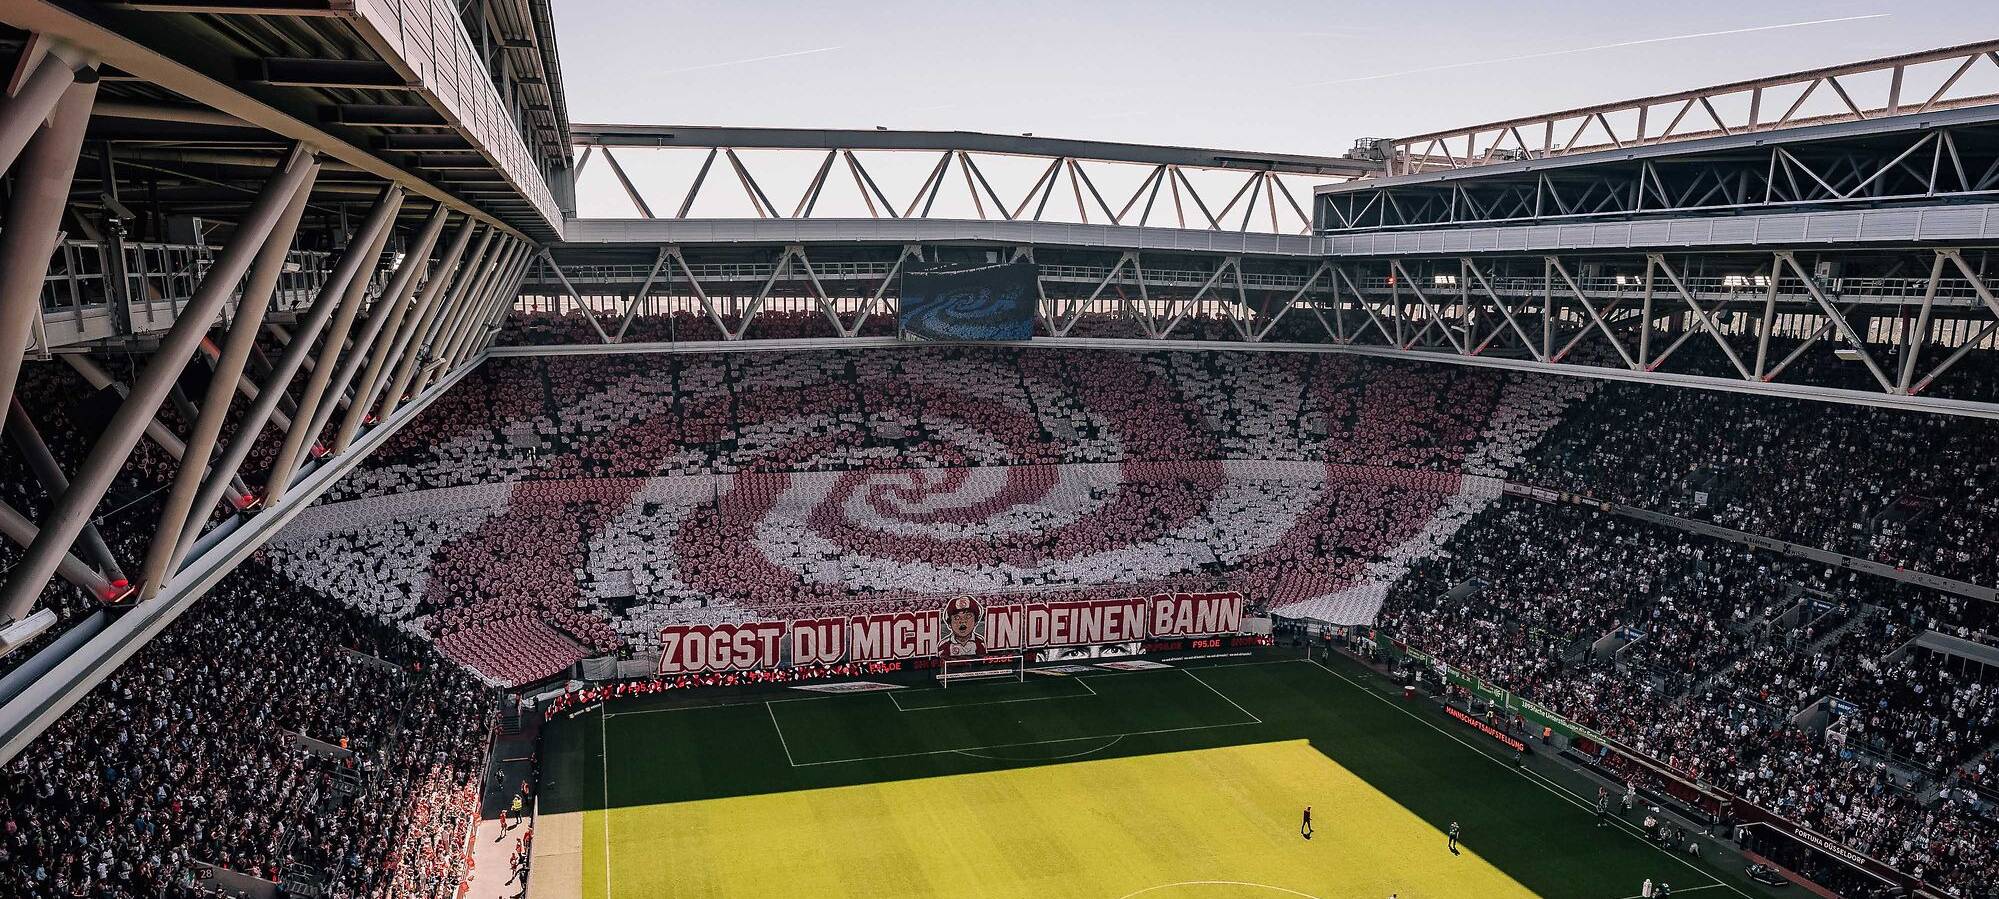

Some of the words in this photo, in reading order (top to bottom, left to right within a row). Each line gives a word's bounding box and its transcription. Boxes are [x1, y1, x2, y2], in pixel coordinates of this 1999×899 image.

[660, 625, 783, 673] ZOGST
[794, 620, 844, 664] DU
[851, 614, 939, 660] MICH
[987, 609, 1021, 649] IN
[1028, 603, 1145, 646] DEINEN
[1155, 596, 1241, 635] BANN
[1192, 639, 1221, 649] F95.DE
[1446, 705, 1524, 751] MANNSCHAFTSAUFSTELLUNG
[1794, 828, 1823, 845] FORTUNA
[1823, 840, 1866, 865] DÜSSELDORF
[200, 869, 213, 879] 28
